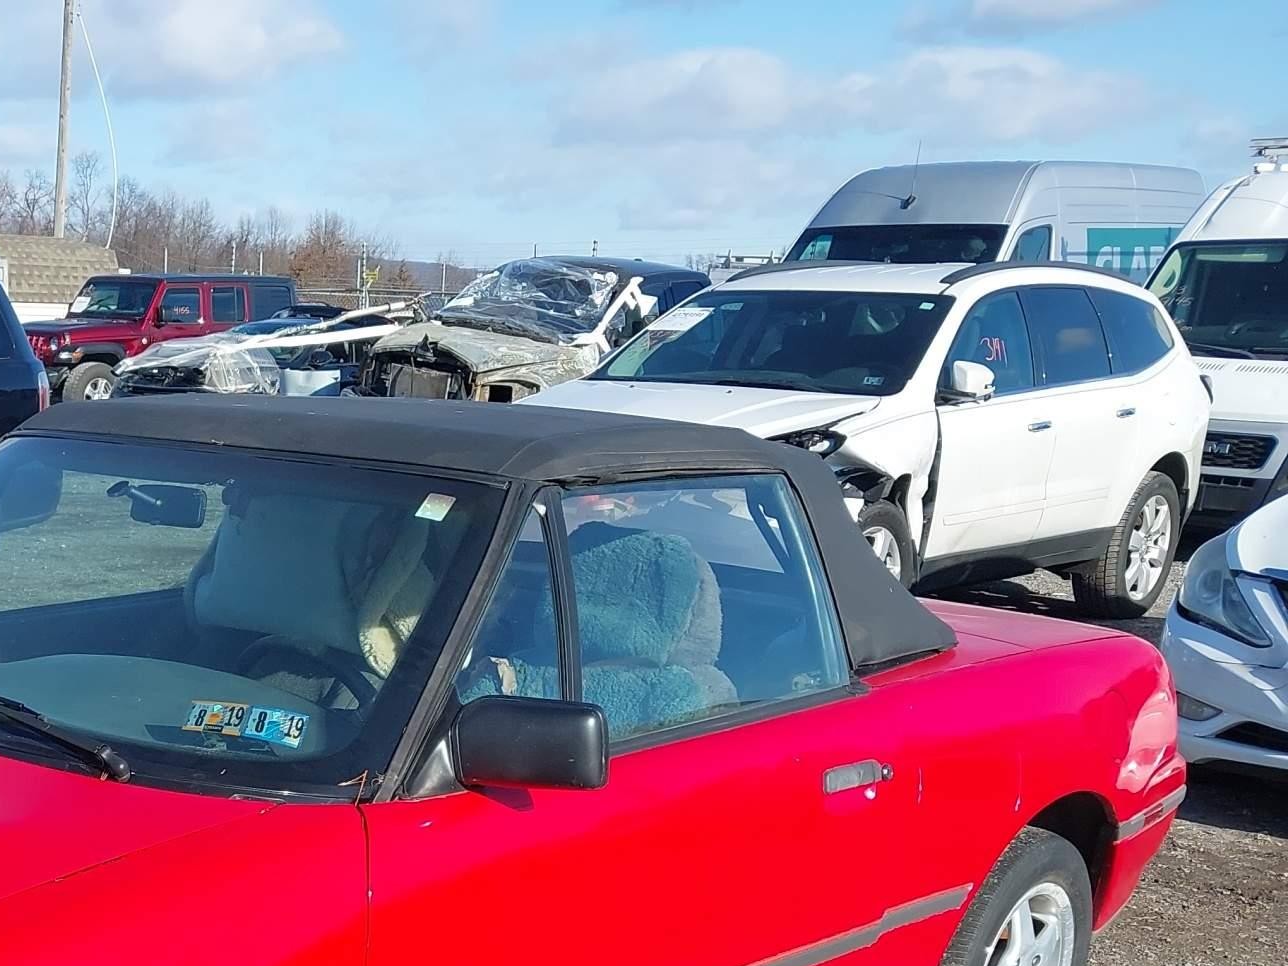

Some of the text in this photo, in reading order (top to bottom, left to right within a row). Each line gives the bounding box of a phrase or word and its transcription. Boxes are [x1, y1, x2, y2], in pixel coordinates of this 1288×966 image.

[194, 706, 245, 727] 8 19
[255, 711, 304, 739] 8 19
